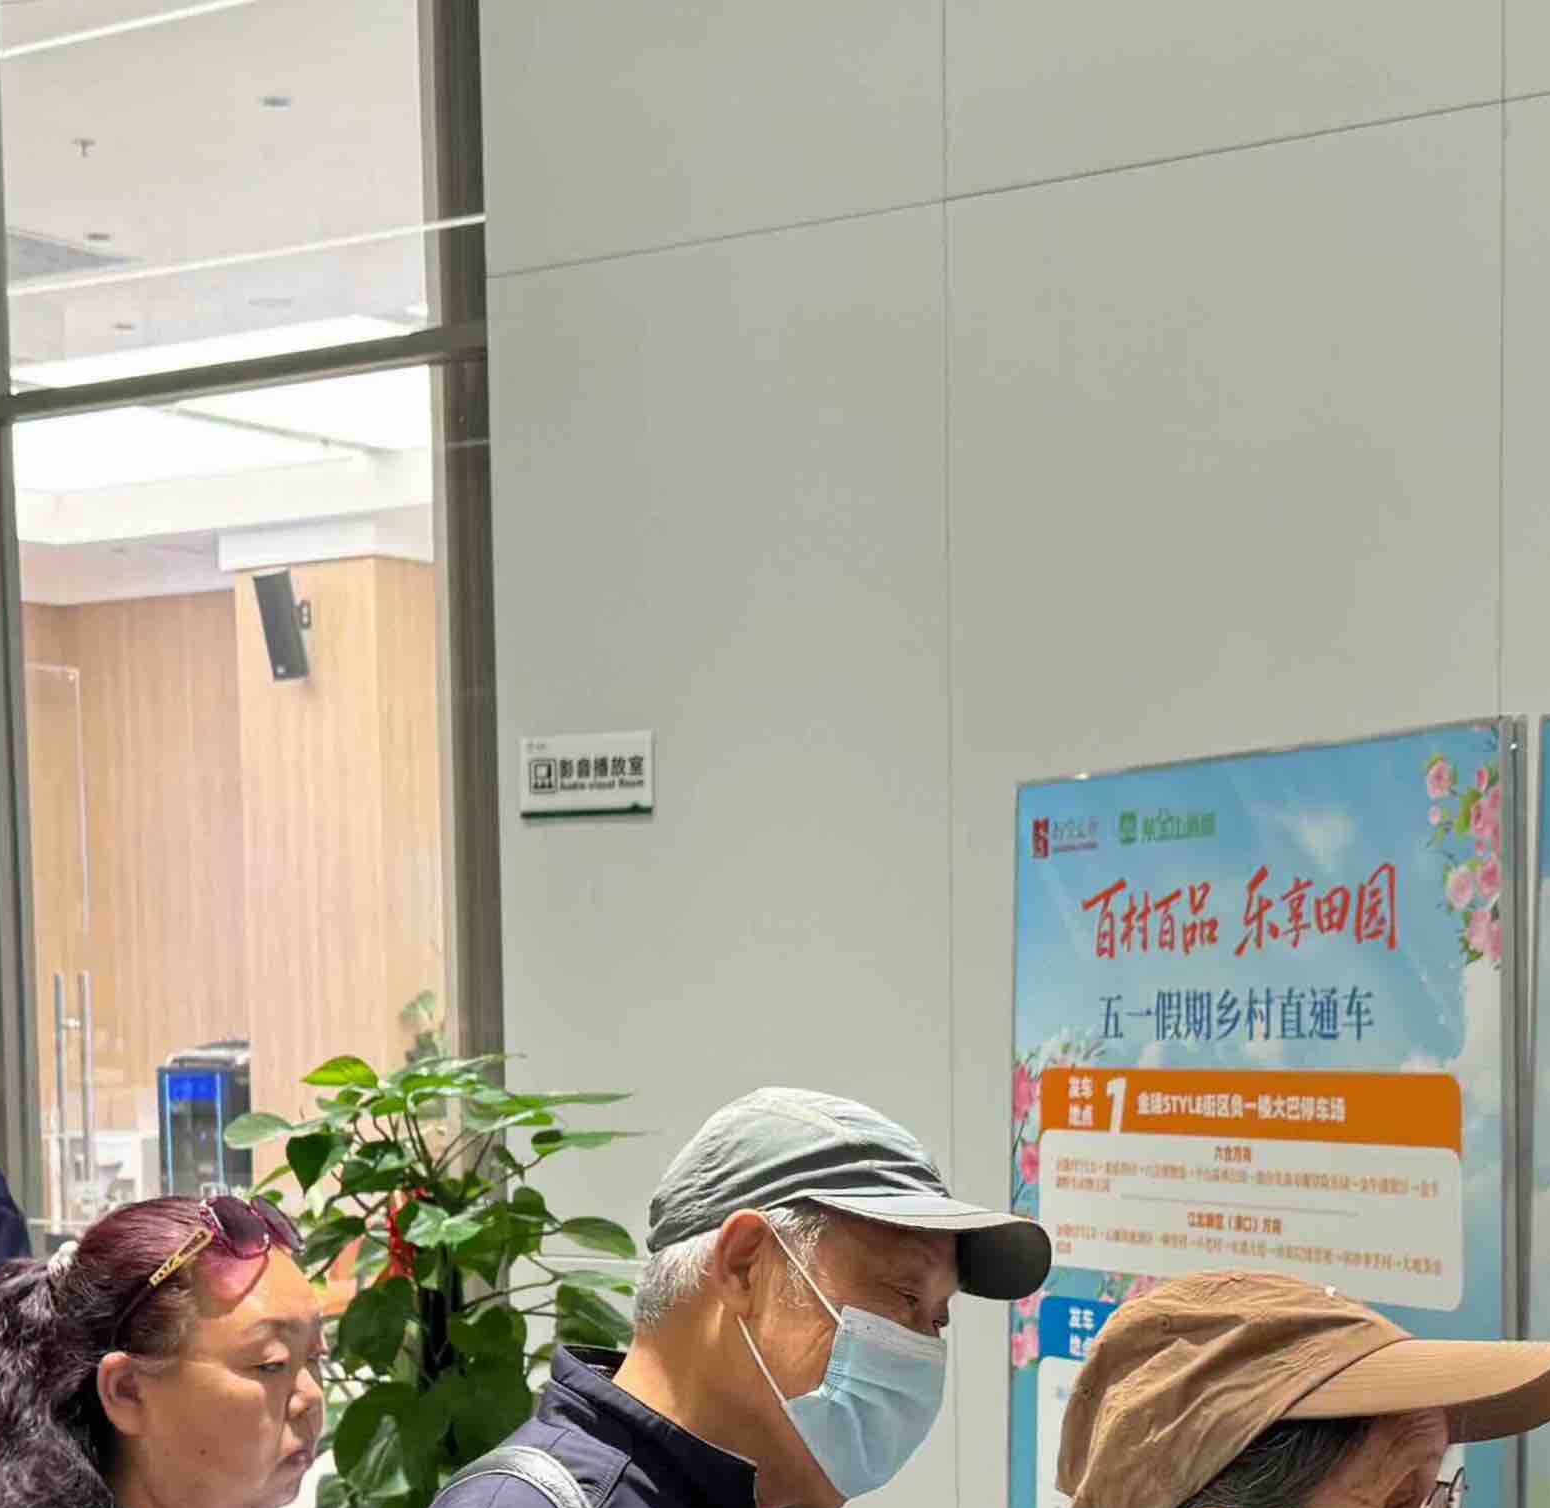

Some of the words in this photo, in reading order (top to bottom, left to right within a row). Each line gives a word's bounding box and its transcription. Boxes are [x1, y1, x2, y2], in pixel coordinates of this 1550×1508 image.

[1082, 879, 1219, 959] 百村百品
[1233, 862, 1397, 957] 乐享田园
[1098, 984, 1375, 1042] 五一假期乡村直通车
[1106, 1077, 1128, 1136] 1
